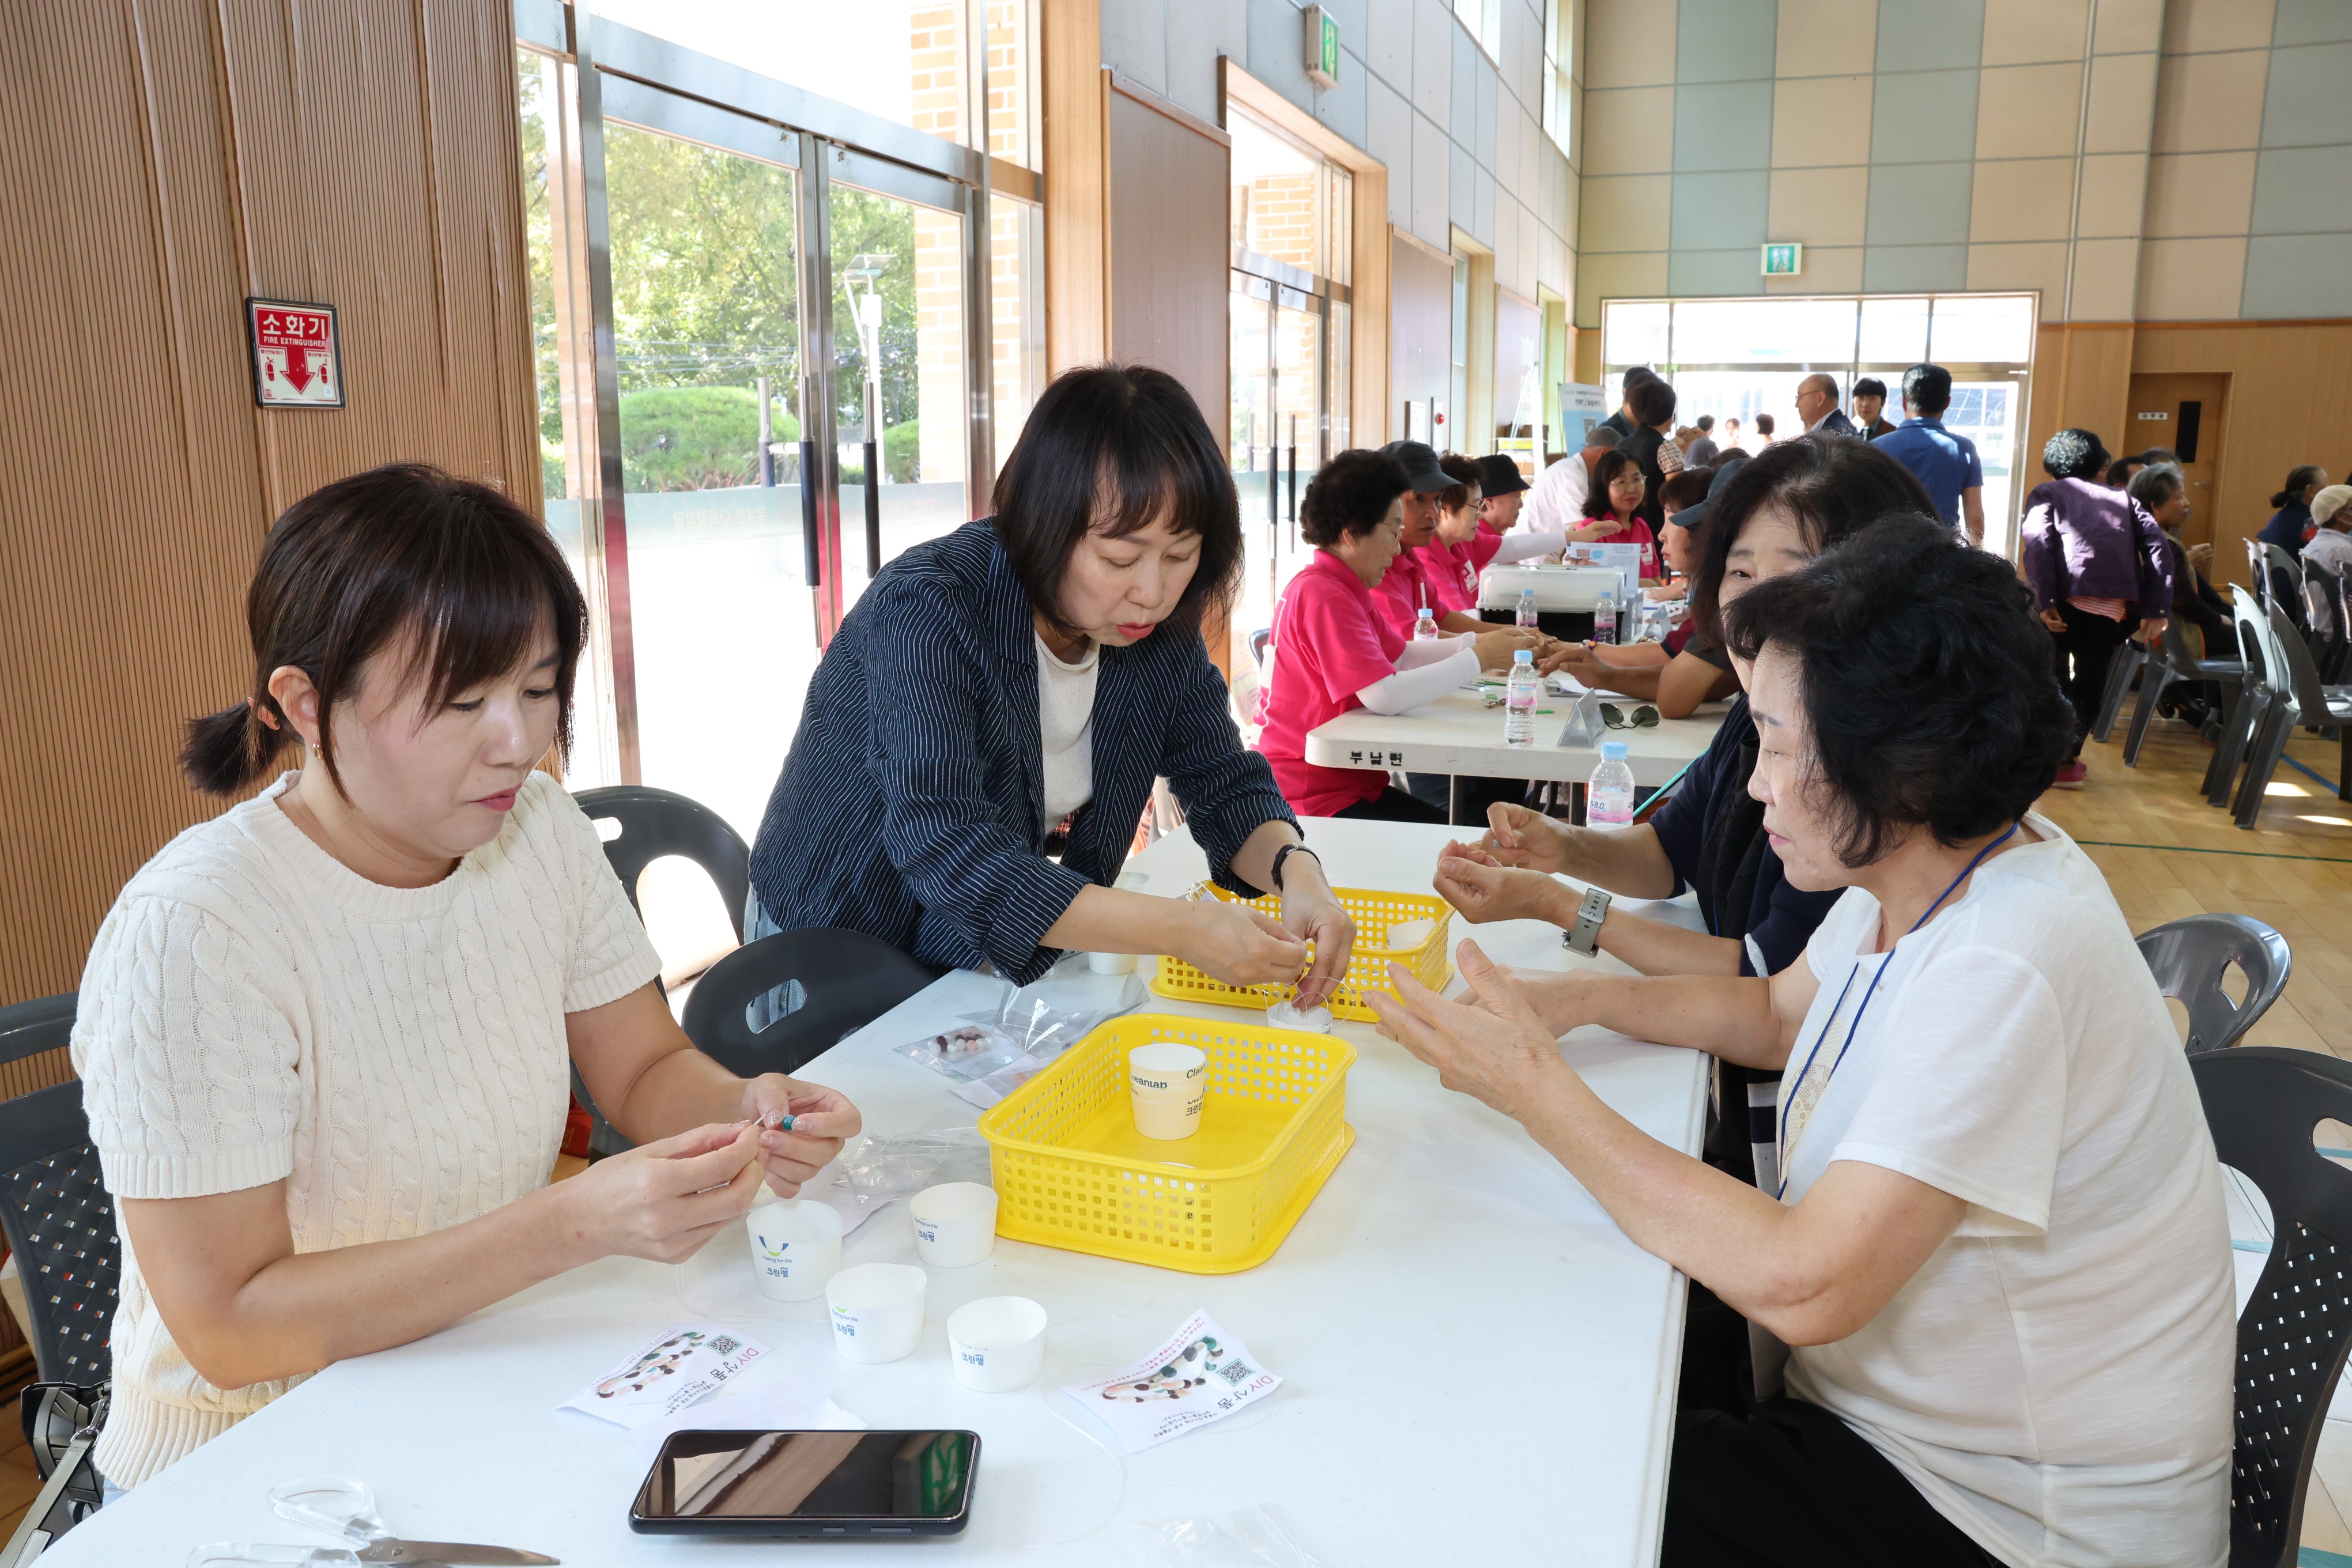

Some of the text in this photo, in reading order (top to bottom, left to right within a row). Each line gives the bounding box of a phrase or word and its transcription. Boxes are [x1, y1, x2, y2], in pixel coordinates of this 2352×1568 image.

[263, 314, 325, 339] 소화기
[264, 336, 325, 347] FIRE EXTINGUISHER
[1350, 751, 1402, 766] 부남면
[737, 1348, 759, 1365] DIY
[1249, 1376, 1273, 1392] DIY
